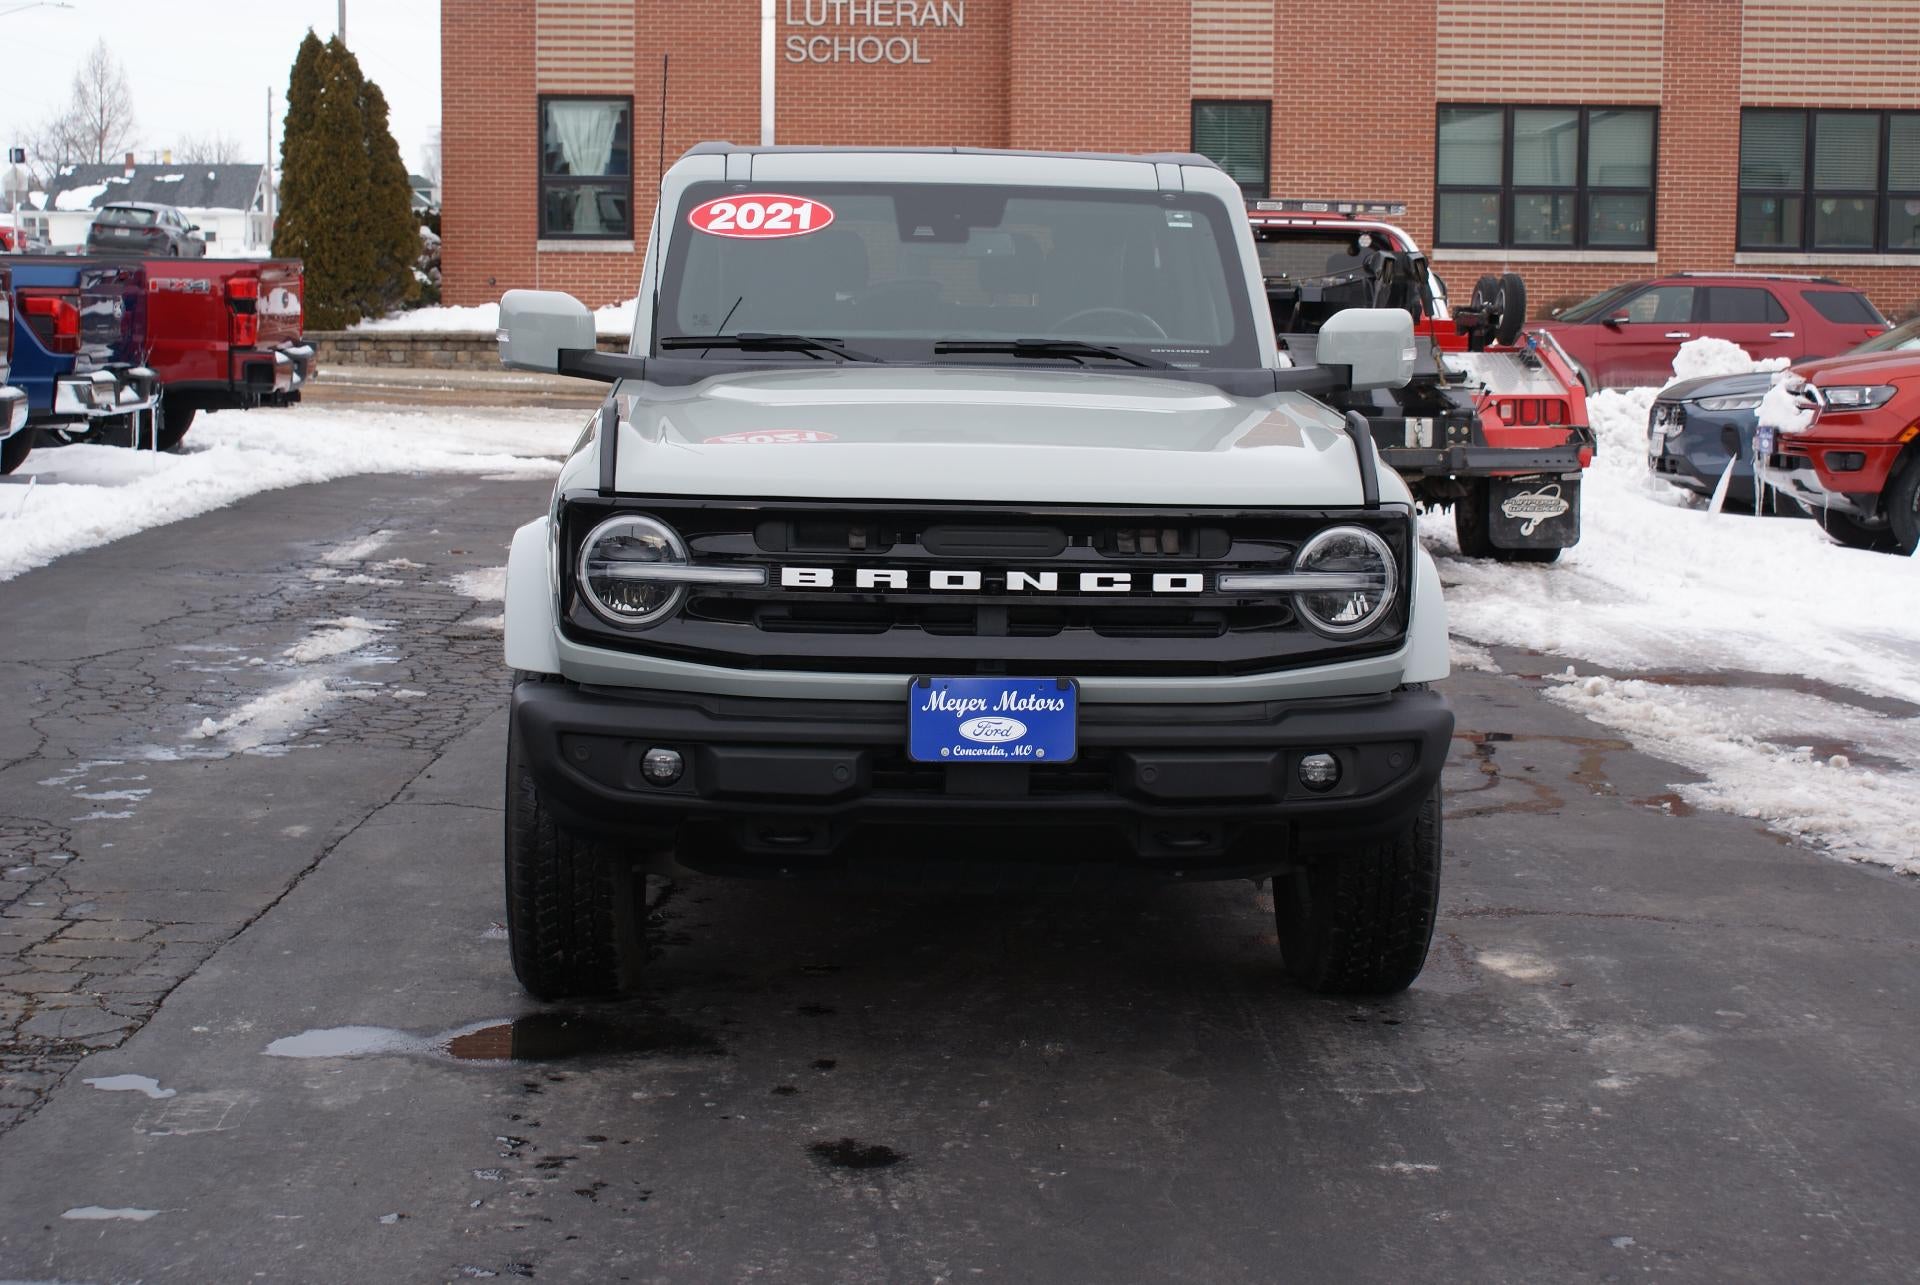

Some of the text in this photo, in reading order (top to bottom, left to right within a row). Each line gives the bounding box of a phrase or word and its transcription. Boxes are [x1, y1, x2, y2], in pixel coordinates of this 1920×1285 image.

[785, 0, 964, 27] LUTHERAN
[785, 36, 931, 64] SCHOOL
[707, 202, 813, 230] 2021
[781, 567, 1204, 592] BRONCO
[921, 690, 1065, 718] Meyer Motors
[972, 720, 1013, 737] Ford
[953, 745, 1033, 758] Concordia, MO
